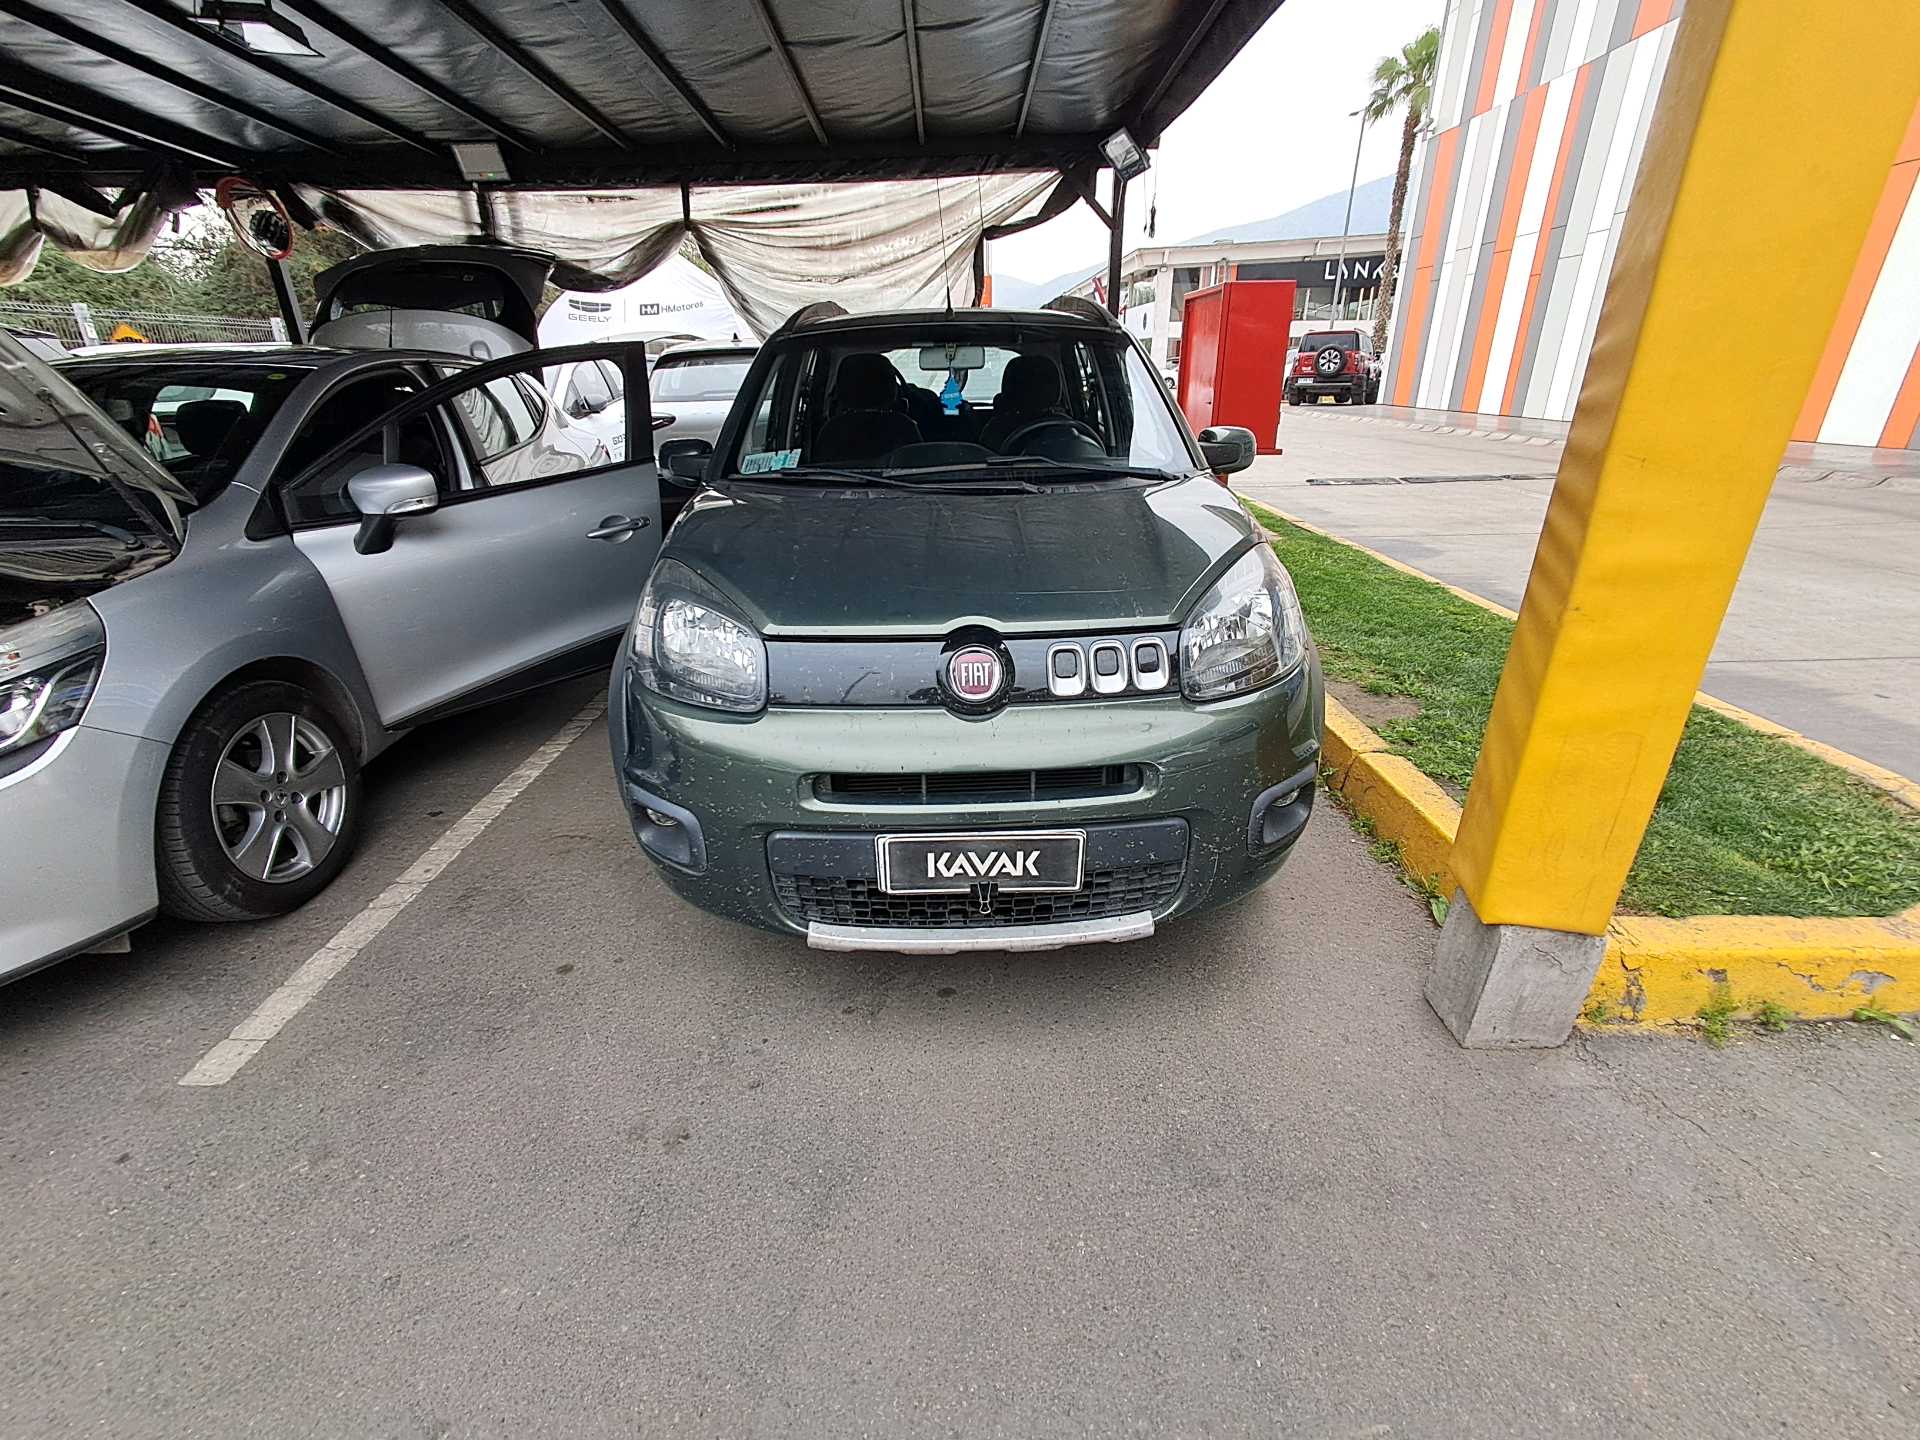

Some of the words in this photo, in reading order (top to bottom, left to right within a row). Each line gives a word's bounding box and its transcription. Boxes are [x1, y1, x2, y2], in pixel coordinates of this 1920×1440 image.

[568, 313, 612, 322] GEELY
[641, 304, 659, 315] HM
[960, 662, 991, 687] FIAT
[927, 850, 1041, 878] KAVAK
